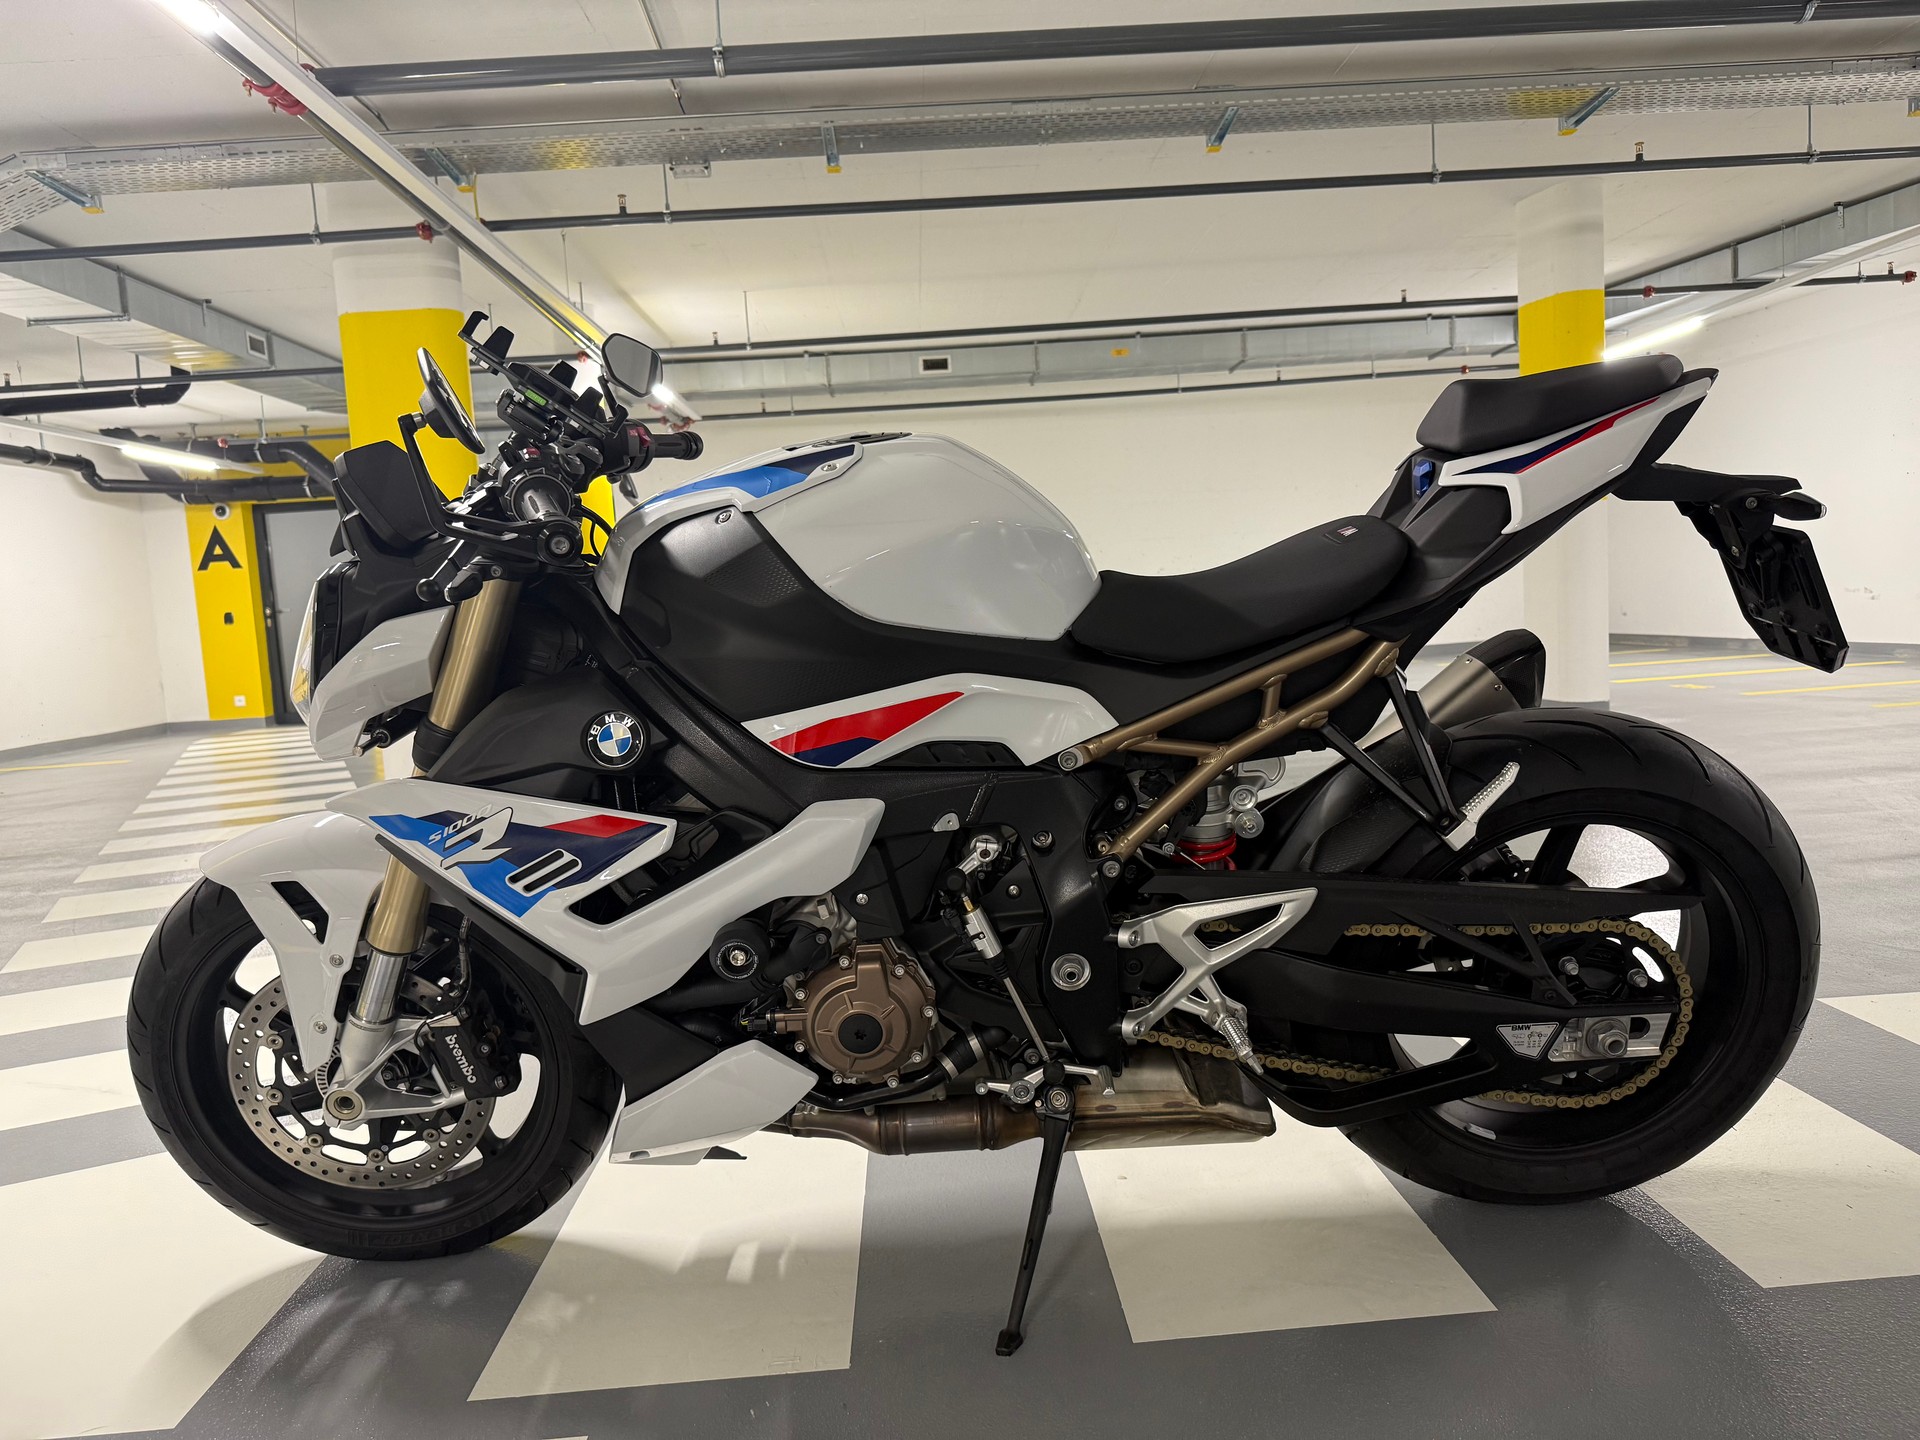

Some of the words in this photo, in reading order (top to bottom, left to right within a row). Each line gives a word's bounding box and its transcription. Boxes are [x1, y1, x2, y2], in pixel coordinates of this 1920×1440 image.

[197, 524, 243, 571] A
[590, 713, 635, 735] BMW
[428, 803, 493, 846] S1000
[445, 1034, 477, 1084] brembo
